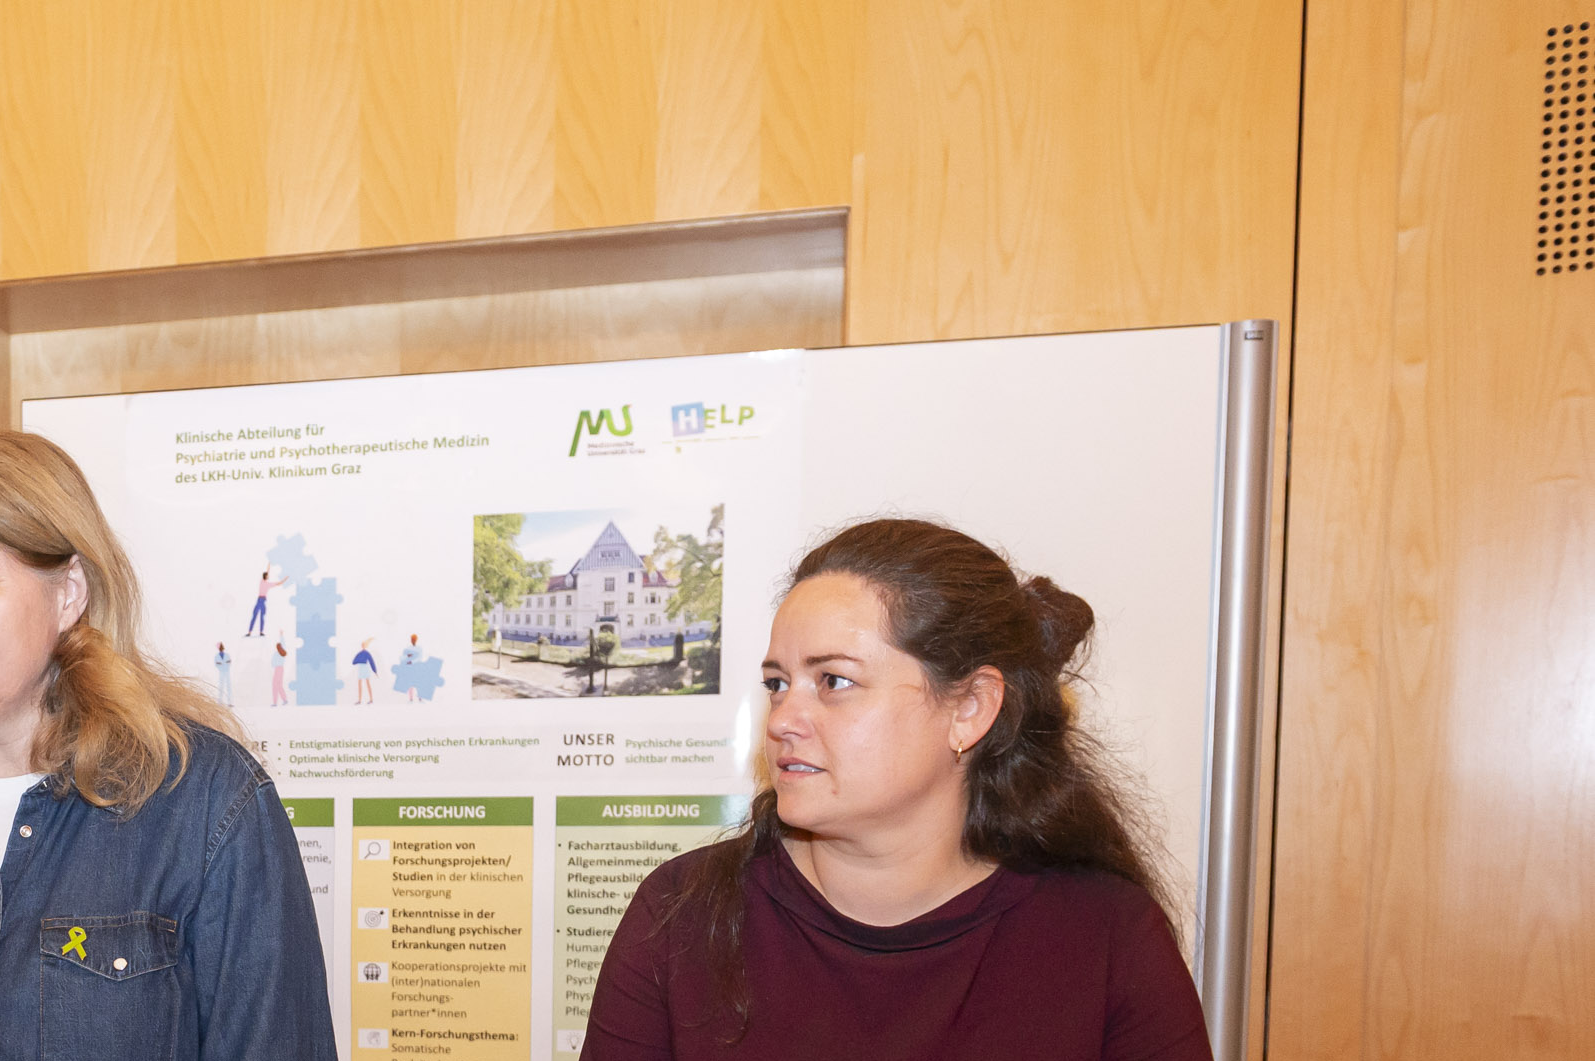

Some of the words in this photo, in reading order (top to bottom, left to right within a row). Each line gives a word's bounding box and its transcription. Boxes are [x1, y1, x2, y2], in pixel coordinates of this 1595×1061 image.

[677, 404, 755, 432] HELP
[176, 430, 233, 444] Klinische
[238, 426, 301, 441] Abteilung
[305, 424, 325, 436] für
[176, 450, 245, 465] Psychiatrie
[250, 448, 275, 460] und
[280, 439, 428, 458] Psychotherapeutische
[433, 435, 489, 449] Medizin
[175, 472, 197, 484] des
[202, 469, 264, 482] LKH-Univ.
[269, 465, 327, 479] Klinikum
[331, 463, 361, 475] Graz
[290, 740, 381, 750] Entstigmatisierung
[384, 740, 402, 748] von
[406, 738, 465, 749] psychischen
[469, 736, 540, 747] Erkrankungen
[564, 734, 614, 745] UNSER
[625, 739, 682, 749] Psychische
[290, 754, 334, 764] Optimale
[337, 753, 380, 763] klinische
[383, 752, 439, 764] Versorgung
[557, 755, 614, 766] MOTTO
[625, 754, 667, 763] sichtbar
[672, 755, 714, 763] machen
[290, 768, 394, 779] Nachwuchsförderung
[399, 806, 486, 818] FORSCHUNG
[603, 805, 700, 818] AUSBILDUNG
[393, 841, 452, 851] Integration
[568, 841, 681, 852] Facharztausbildung,
[393, 855, 511, 867] Forschungsprojekten/
[392, 873, 433, 881] Studien
[437, 873, 446, 881] in
[449, 873, 466, 881] der
[470, 872, 523, 881] klinischen
[392, 888, 451, 899] Versorgung
[567, 889, 620, 899] klinische-
[392, 910, 460, 918] Erkenntnisse
[464, 910, 473, 918] in
[477, 910, 495, 918] der
[392, 925, 455, 936] Behandlung
[459, 926, 522, 936] psychischer
[391, 941, 465, 951] Erkrankungen
[469, 942, 506, 950] nutzen
[391, 963, 505, 974] Kooperationsprojekte
[509, 964, 526, 972] mit
[391, 978, 480, 988] (inter)nationalen
[391, 992, 454, 1003] Forschungs-
[391, 1030, 518, 1041] Kern-Forschungsthema:
[391, 1044, 451, 1054] Somatische
